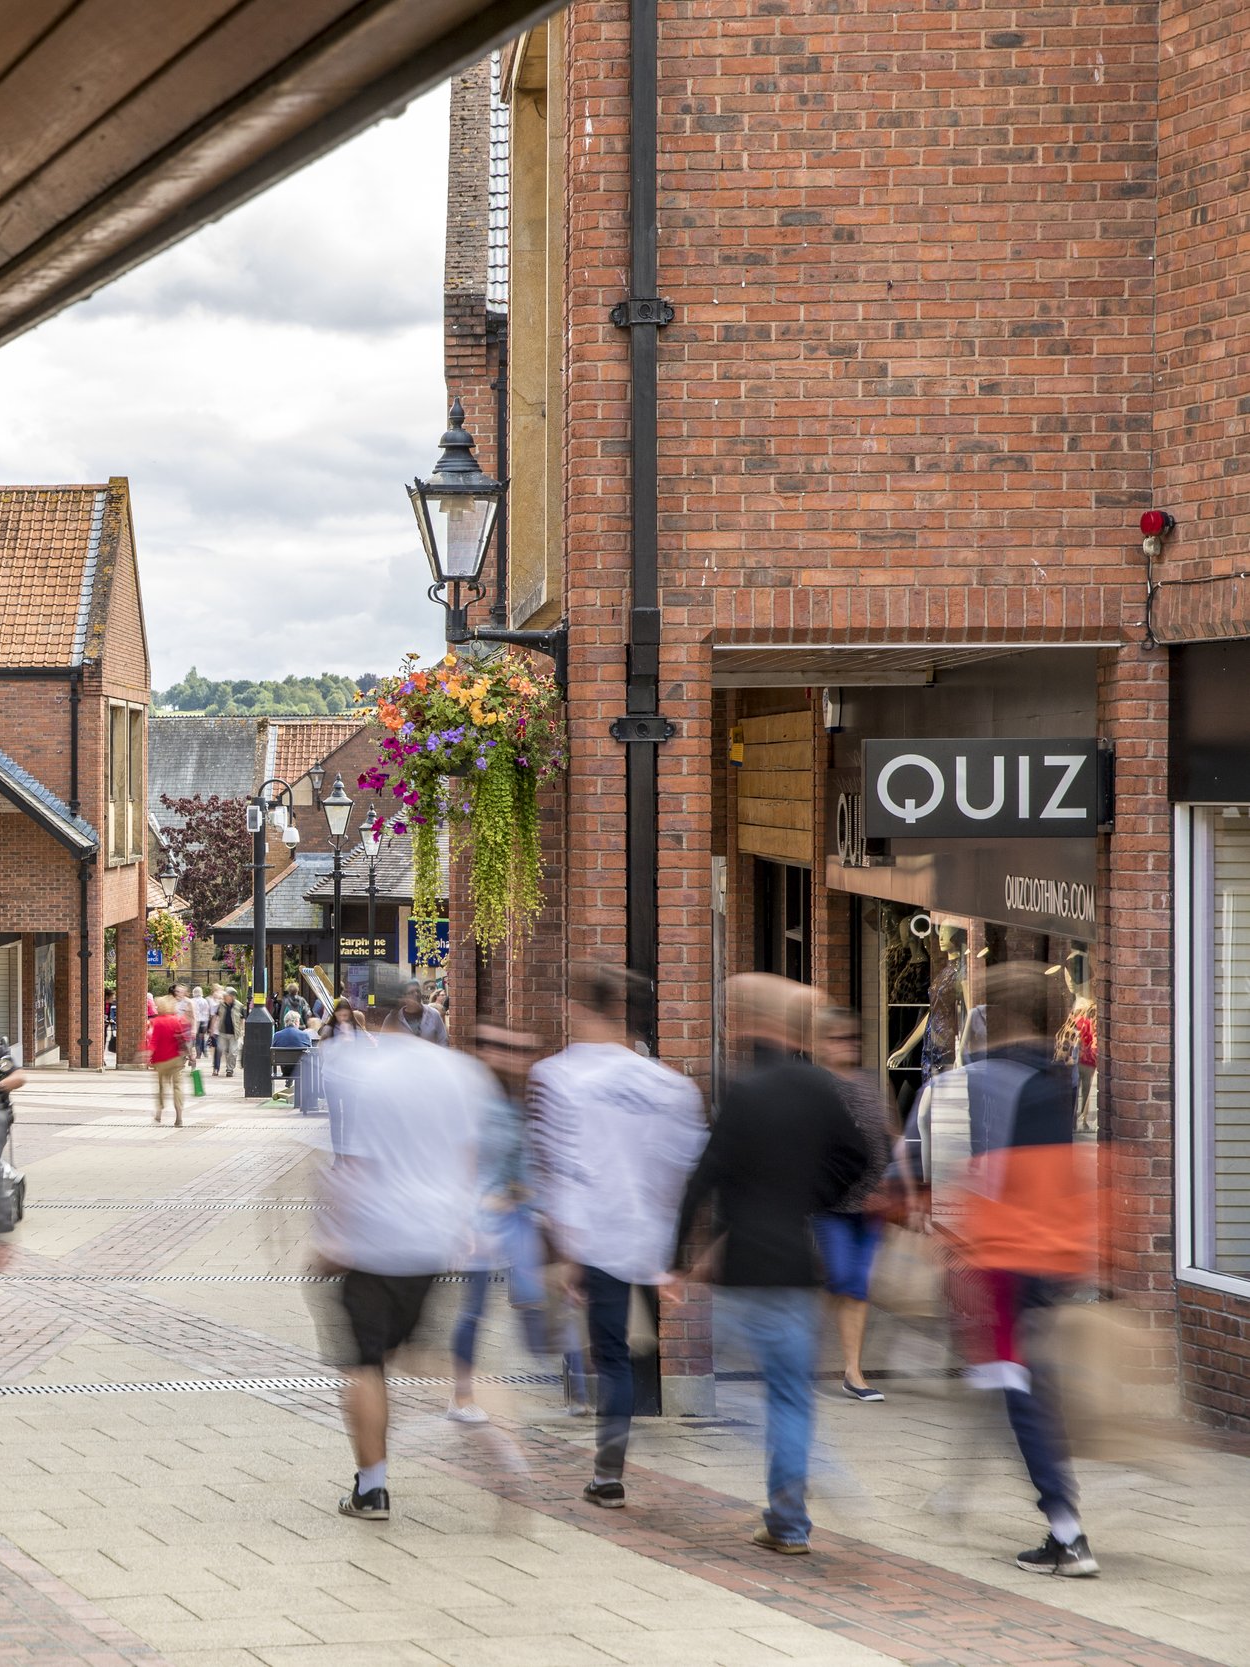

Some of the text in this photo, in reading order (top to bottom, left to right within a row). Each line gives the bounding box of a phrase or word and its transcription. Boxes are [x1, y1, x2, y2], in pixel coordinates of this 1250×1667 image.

[876, 753, 1088, 824] QUIZ
[1005, 874, 1096, 923] QUIZCLOTHING.COM
[340, 938, 387, 948] Carphne
